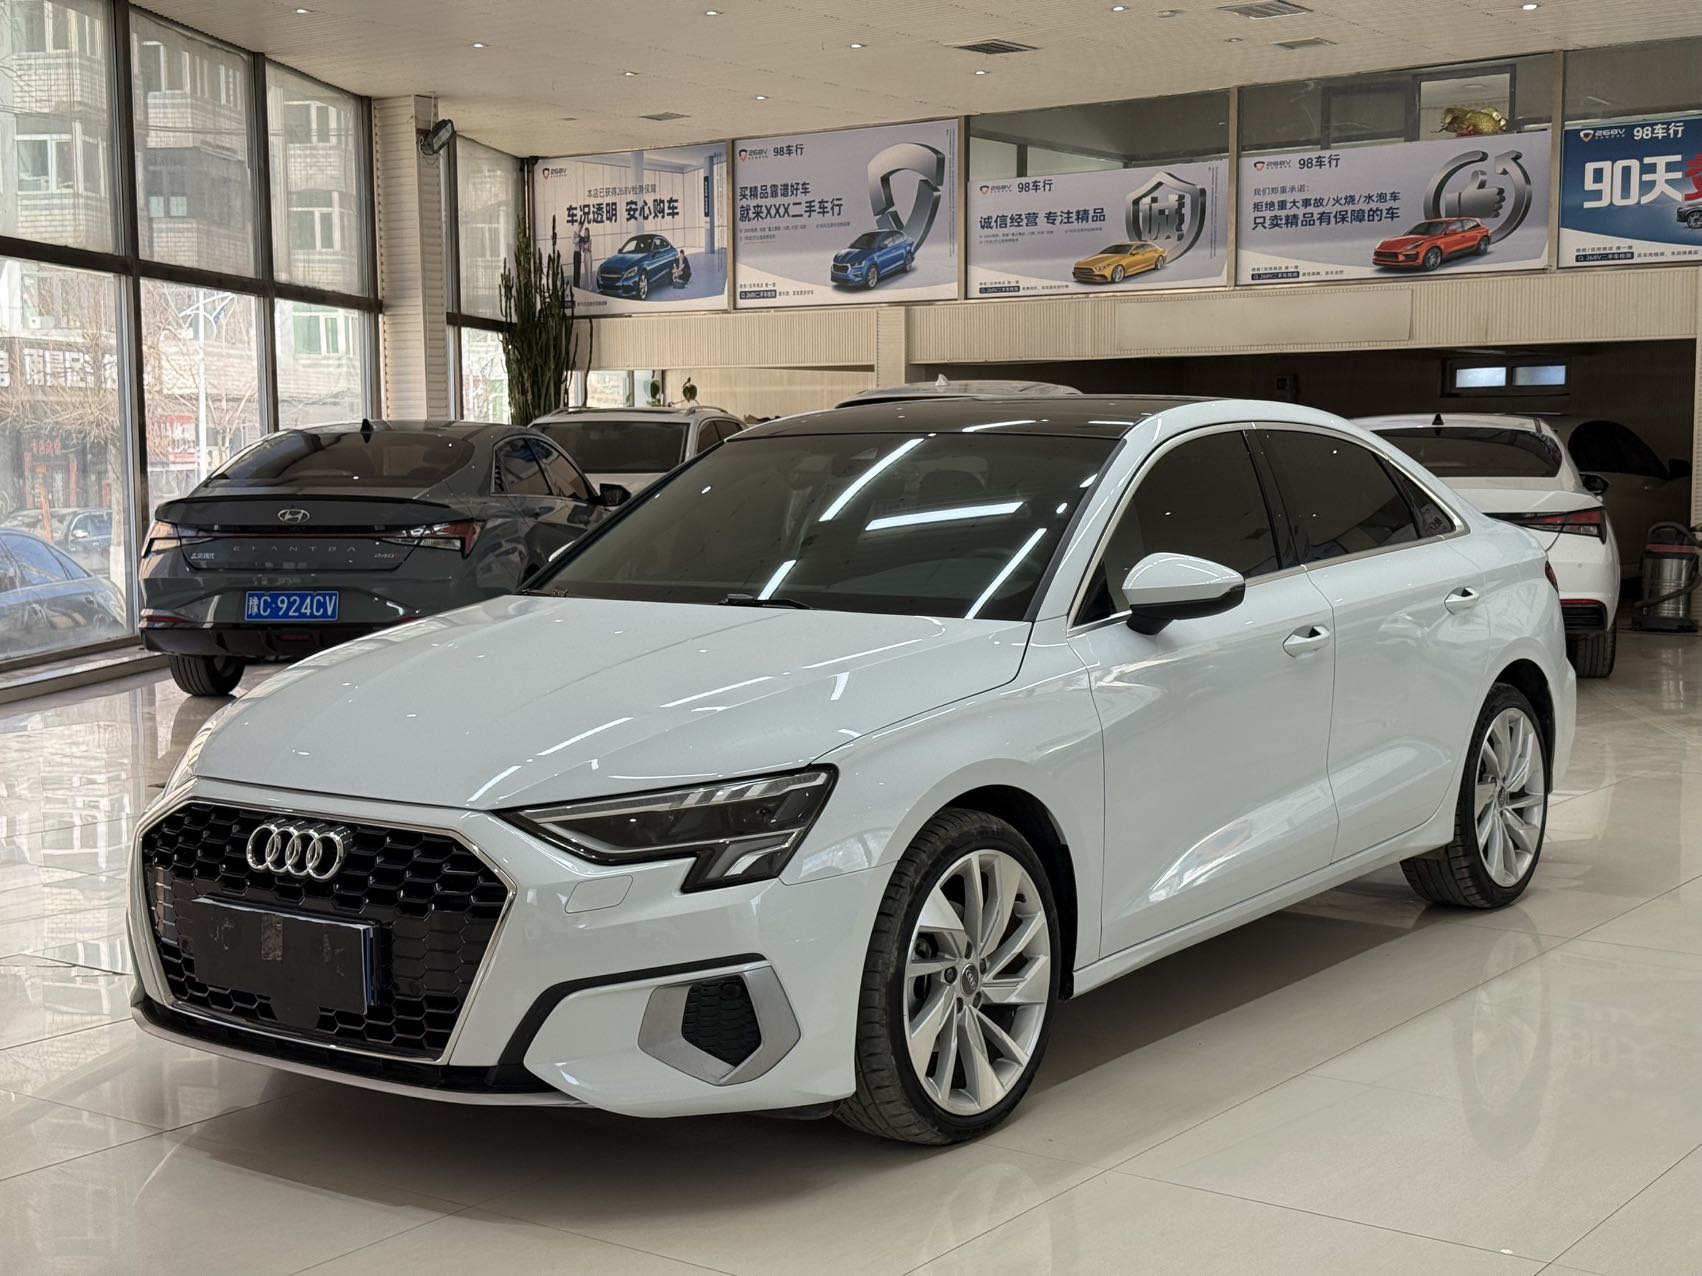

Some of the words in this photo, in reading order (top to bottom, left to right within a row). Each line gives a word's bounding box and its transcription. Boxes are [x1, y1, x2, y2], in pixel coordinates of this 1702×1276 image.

[1633, 122, 1685, 140] 98车行
[773, 143, 804, 157] 98车行
[1298, 153, 1341, 170] 98车行
[739, 181, 811, 201] 买精品靠谱好车
[1017, 179, 1054, 193] 98车行
[566, 202, 618, 226] 车况透明
[625, 197, 679, 222] 安心购车
[738, 197, 843, 223] 就来XXX二手车行
[1252, 191, 1401, 213] 拒绝重大事故/火烧/水泡车
[979, 211, 1039, 231] 诚信经营
[1044, 207, 1106, 226] 专注精品
[1252, 206, 1400, 231] 只卖精品有保障的车
